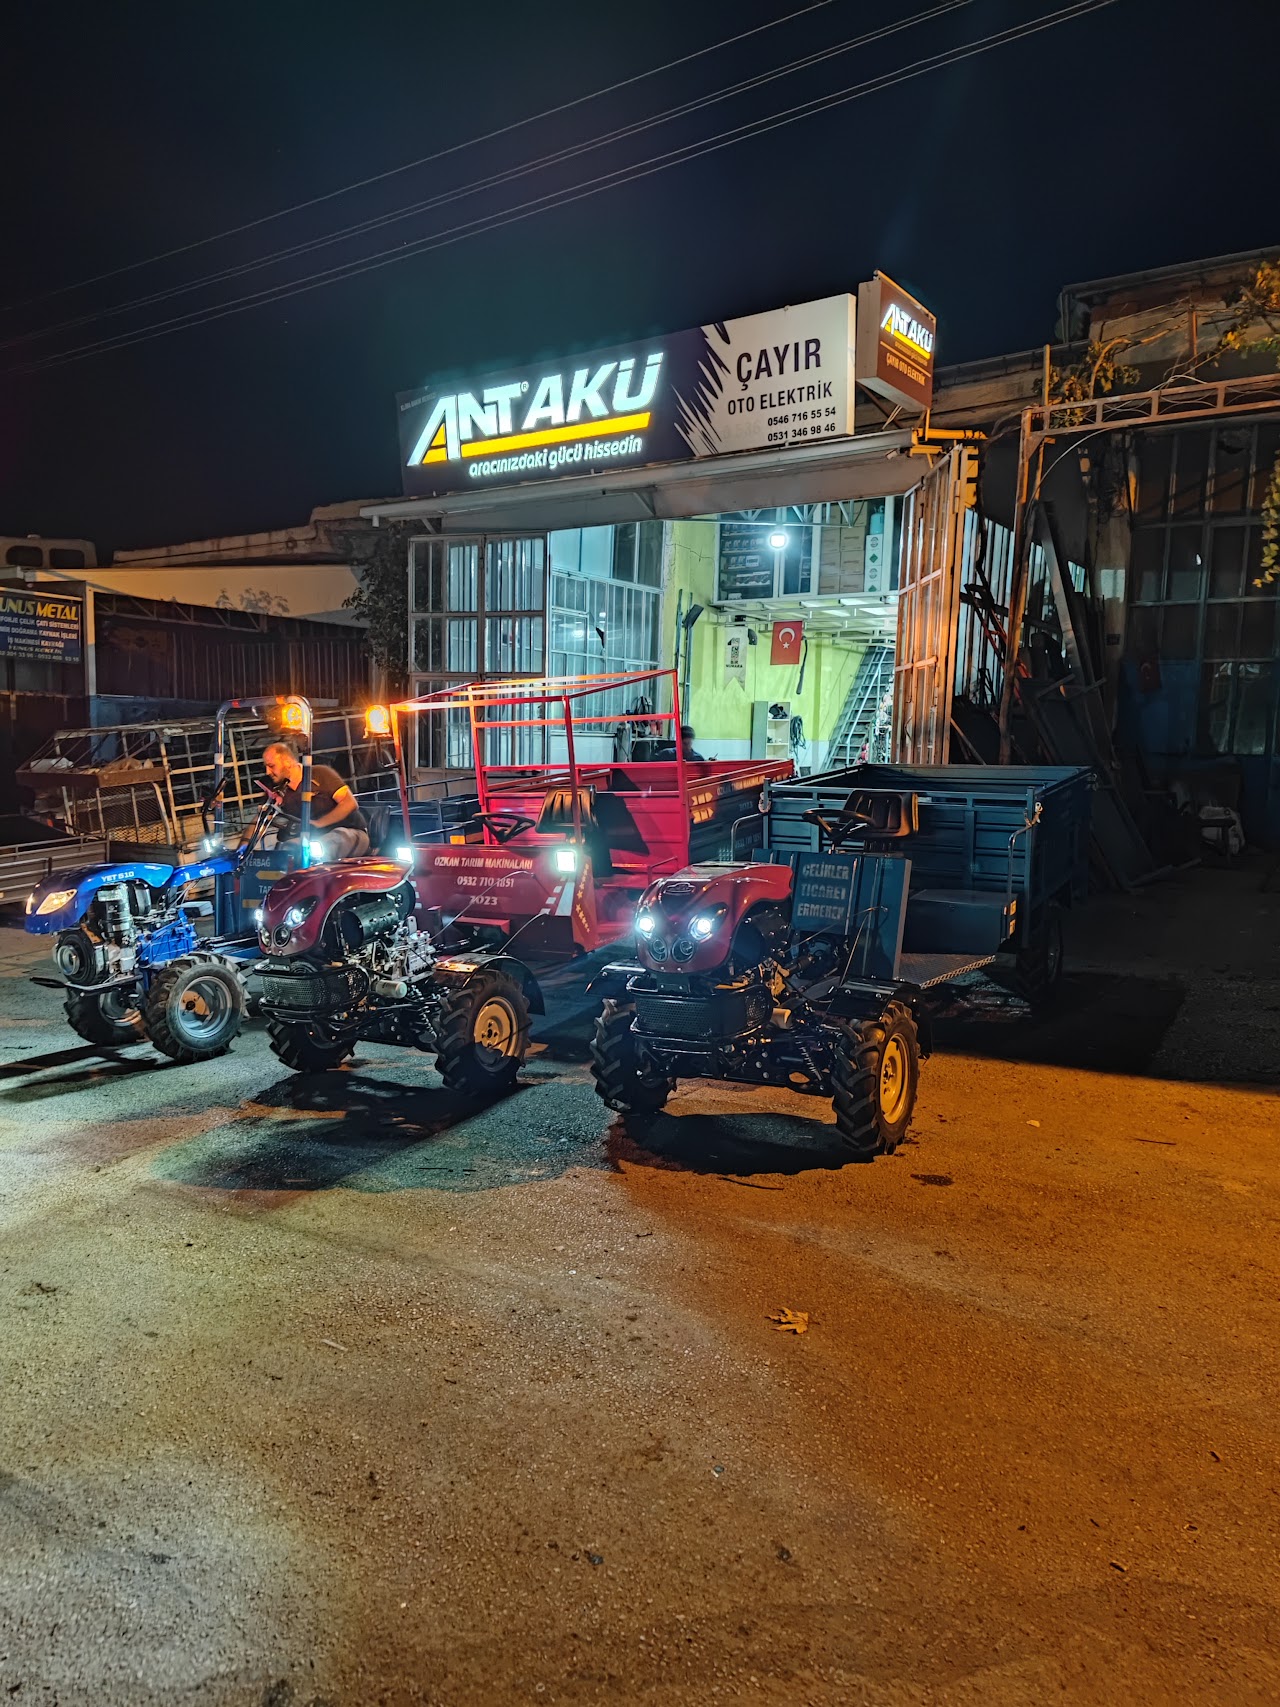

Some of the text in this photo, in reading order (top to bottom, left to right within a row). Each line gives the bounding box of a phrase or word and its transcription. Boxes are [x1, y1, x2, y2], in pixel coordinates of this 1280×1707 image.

[737, 338, 822, 391] ÇAYIR
[728, 380, 833, 416] OTO ELEKTRİK
[767, 406, 836, 427] 0546 716 55 54
[767, 422, 836, 442] 0531 346 98 46
[469, 434, 642, 478] aracınızdaki gücü hissedin
[36, 602, 79, 621] METAL
[461, 857, 484, 868] TARIM
[457, 875, 478, 886] 0532
[479, 877, 494, 887] 710
[470, 895, 498, 906] 2023
